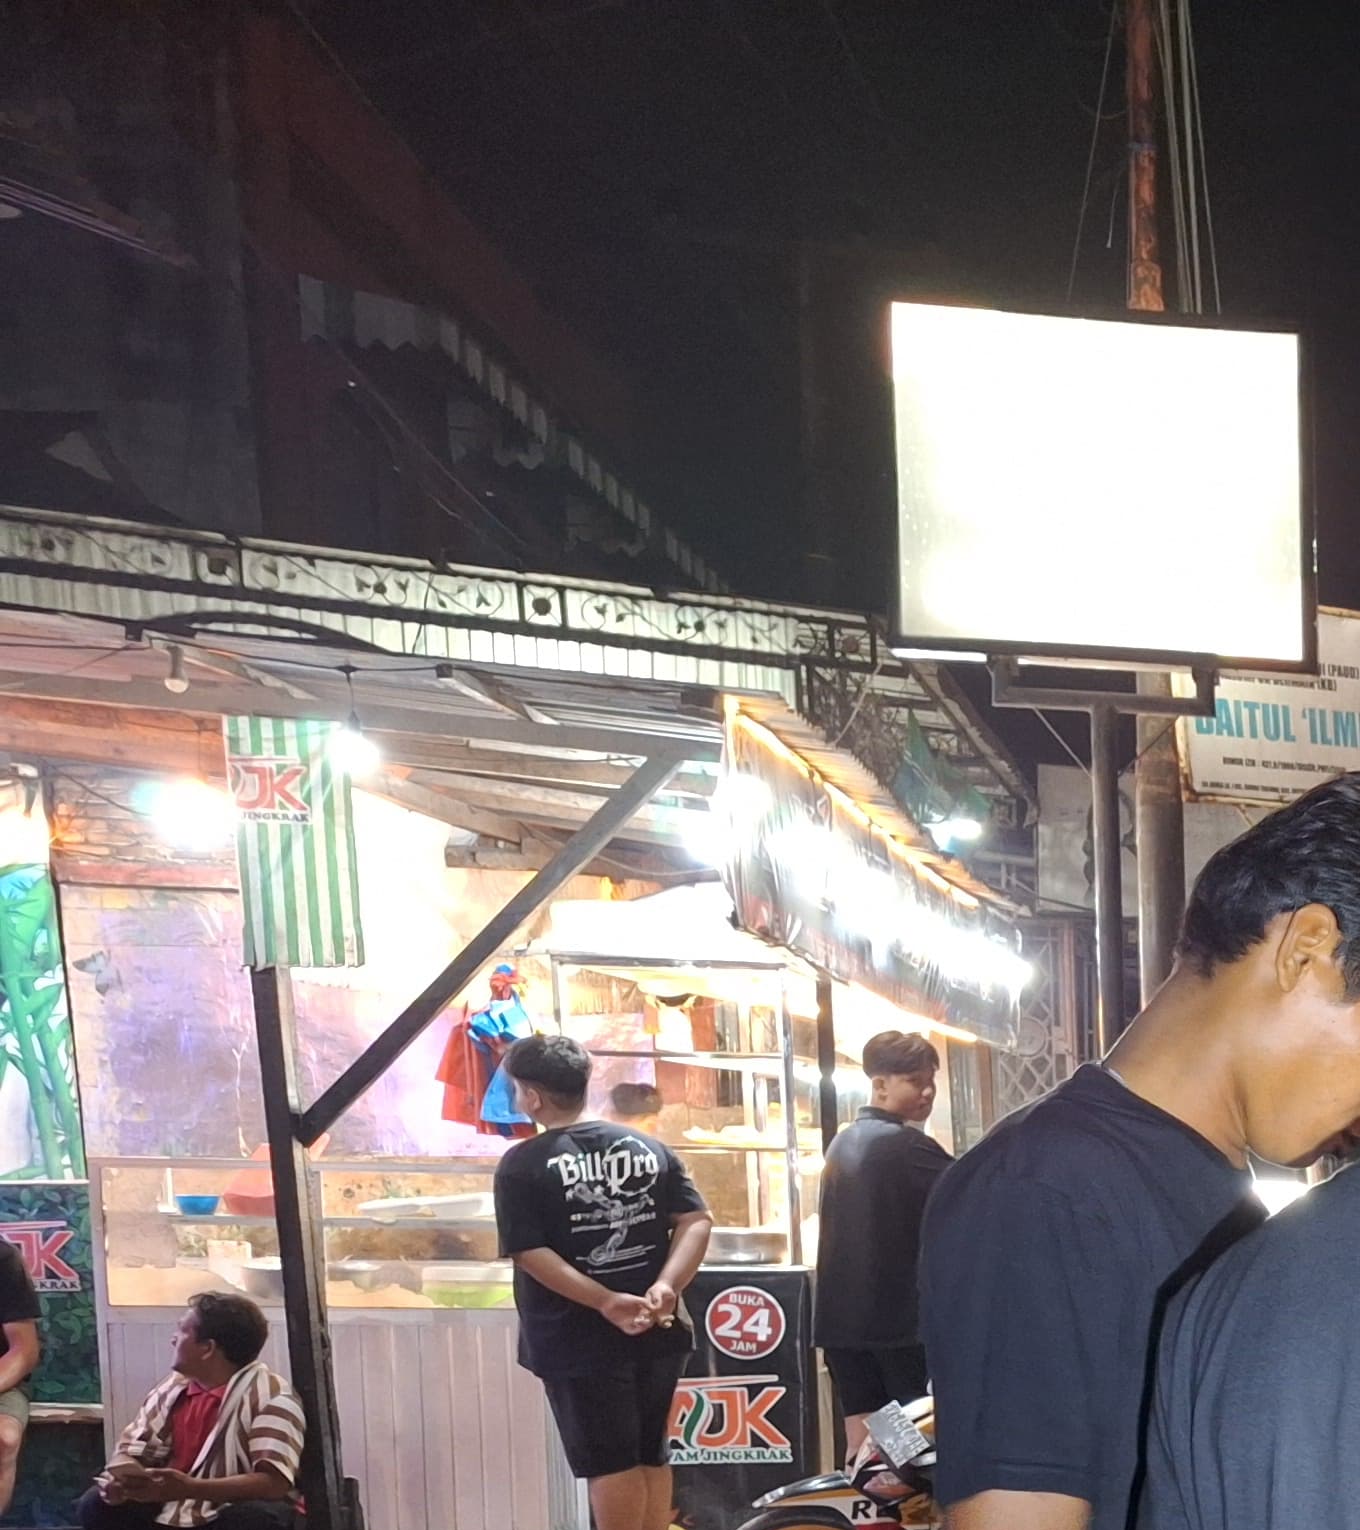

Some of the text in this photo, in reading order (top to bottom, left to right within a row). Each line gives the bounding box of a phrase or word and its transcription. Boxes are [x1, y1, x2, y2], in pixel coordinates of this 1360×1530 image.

[729, 1293, 766, 1307] BUKA
[714, 1303, 773, 1342] 24
[730, 1340, 757, 1353] JAM
[702, 1449, 792, 1463] JINGKRAK
